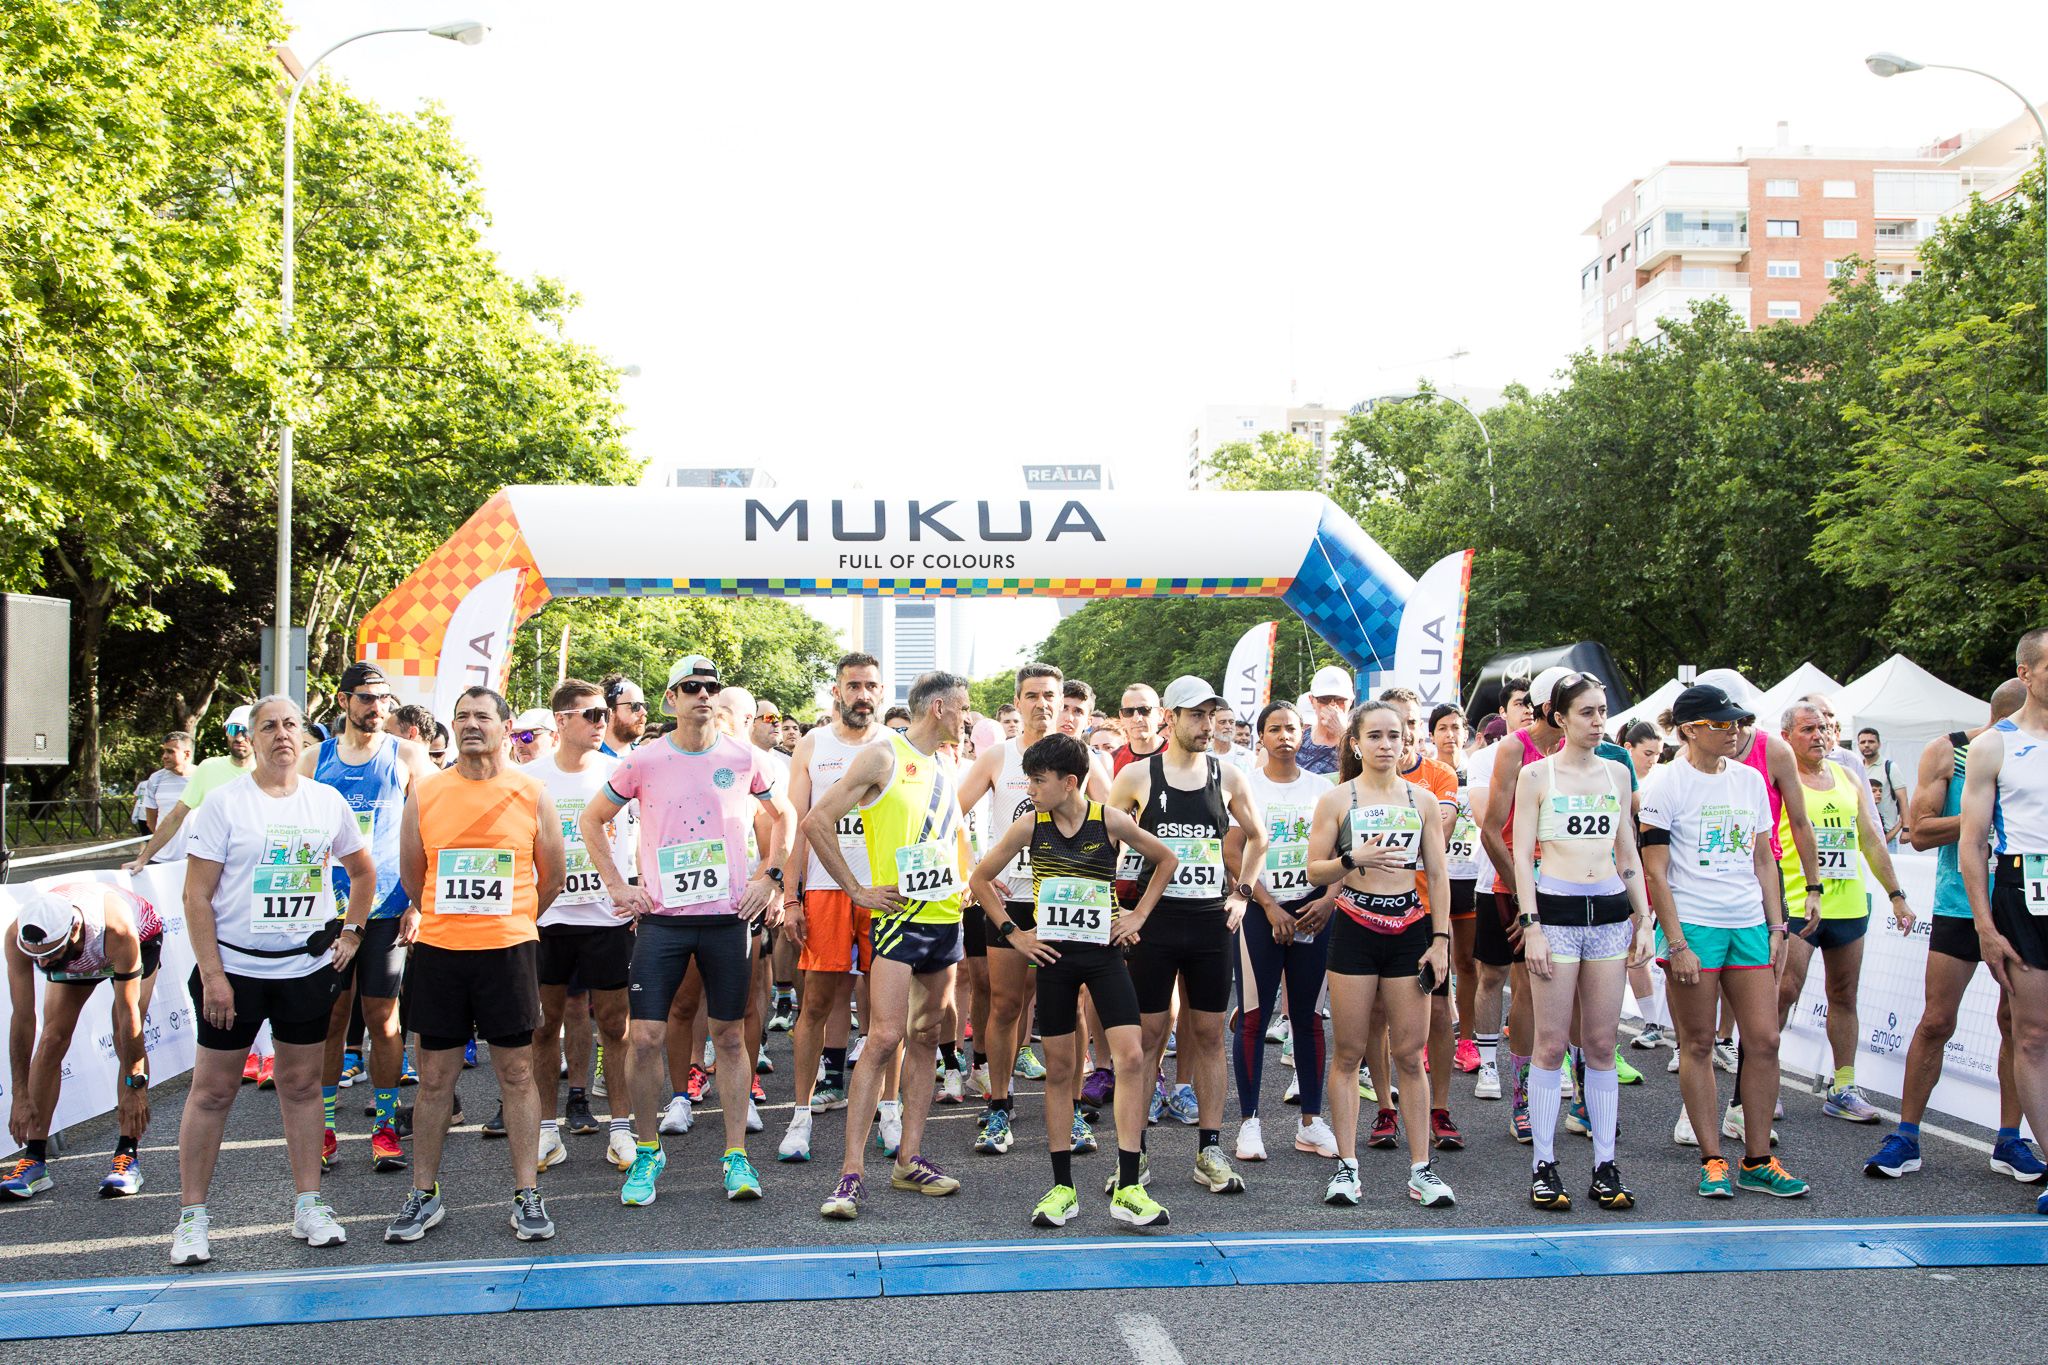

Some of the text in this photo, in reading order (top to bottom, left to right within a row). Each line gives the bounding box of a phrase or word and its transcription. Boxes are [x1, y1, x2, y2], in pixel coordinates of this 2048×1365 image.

[745, 499, 1106, 541] MUKUA
[839, 555, 1015, 569] FULL OF COLOURS
[1364, 809, 1385, 817] 0384
[1641, 806, 1659, 814] KUA
[1567, 815, 1610, 835] 828
[453, 856, 497, 874] ELA
[673, 848, 713, 868] ELA
[1817, 852, 1847, 867] 571
[270, 872, 311, 890] ELA
[445, 879, 503, 900] 1154
[560, 873, 601, 894] 013
[674, 869, 718, 893] 378
[906, 867, 953, 893] 1224
[1054, 883, 1097, 903] ELA
[1370, 896, 1406, 908] PRO
[263, 895, 316, 917] 1177
[1046, 906, 1101, 929] 1143
[1384, 919, 1404, 929] MAX
[1870, 1044, 1885, 1055] tours
[1871, 1029, 1902, 1052] amigo
